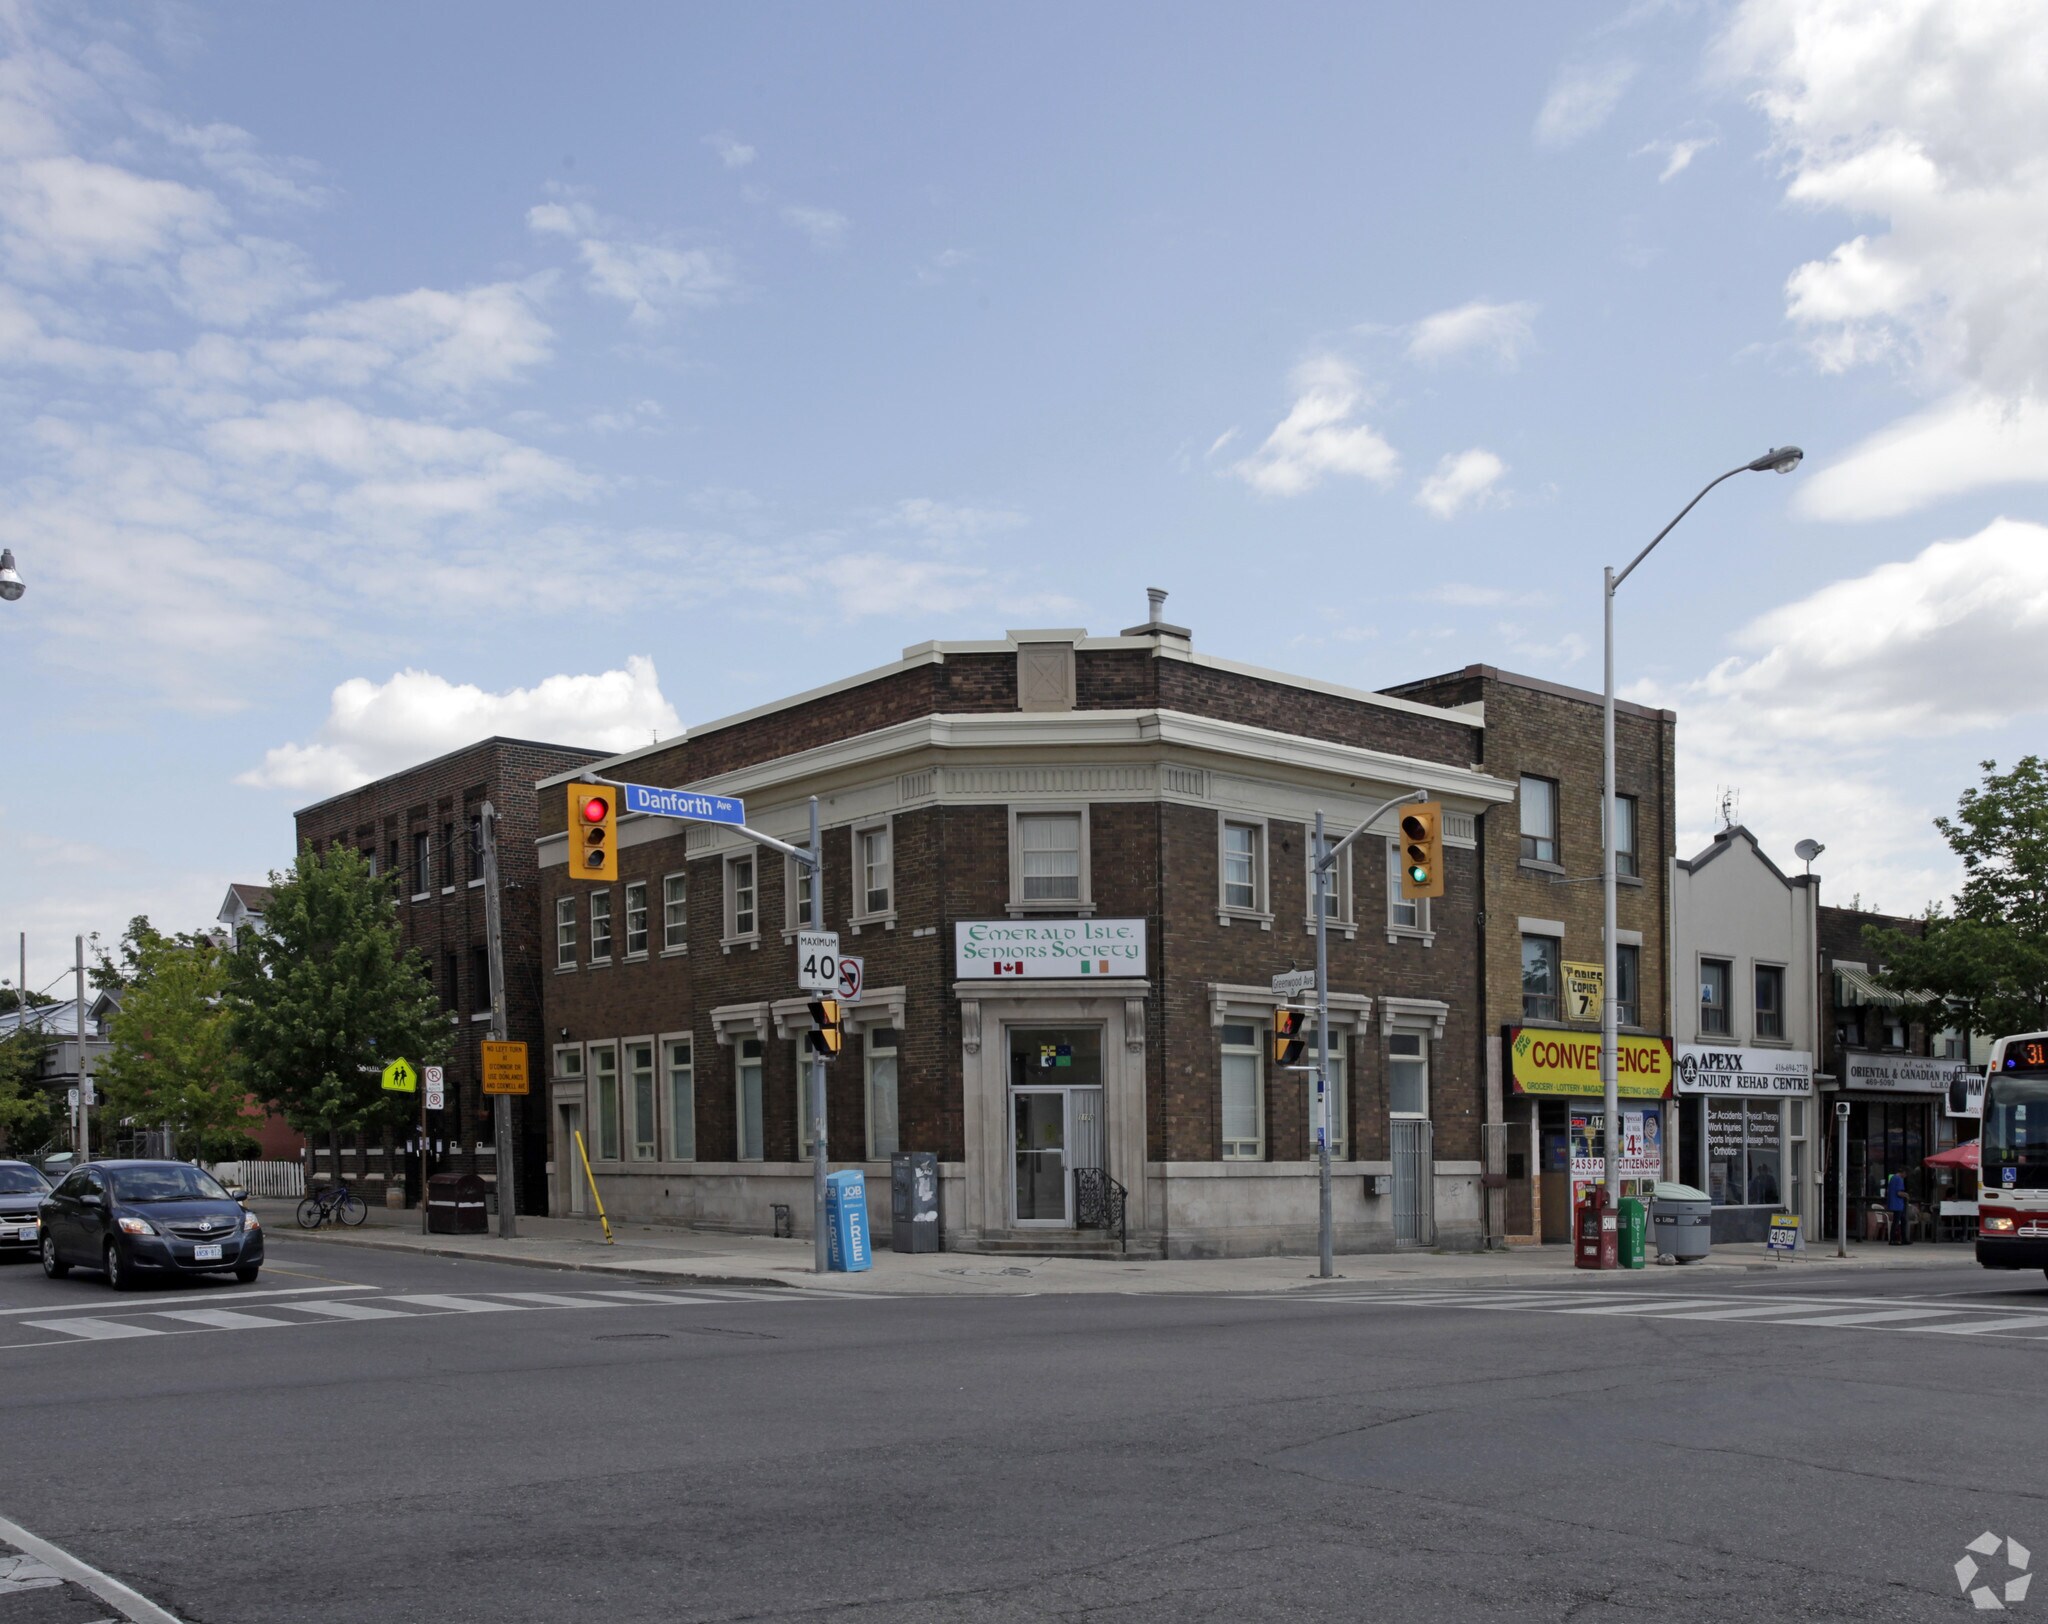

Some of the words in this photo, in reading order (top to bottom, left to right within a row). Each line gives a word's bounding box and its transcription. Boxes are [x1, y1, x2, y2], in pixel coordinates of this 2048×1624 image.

[638, 789, 712, 815] Danforth
[717, 800, 732, 811] Ave
[801, 937, 836, 947] MAXIMUM
[963, 942, 1047, 959] SENIORS
[803, 954, 835, 979] 40
[1274, 977, 1302, 989] Greenwood
[1303, 976, 1313, 986] Ave
[1572, 982, 1597, 994] COPIES
[1532, 1041, 1661, 1074] CONVEENCE
[2027, 1044, 2045, 1064] 31
[1700, 1053, 1743, 1070] APEXX
[1851, 1066, 1889, 1079] ORIENTAL
[1892, 1068, 1898, 1079] &
[1900, 1069, 1940, 1081] CANADIAN
[1698, 1074, 1732, 1088] INJURY
[1737, 1076, 1768, 1089] REHAB
[1773, 1077, 1809, 1090] CENTRE
[1527, 1081, 1553, 1091] GROCERY
[1556, 1083, 1580, 1092] LOTTERY
[1643, 1087, 1660, 1096] CARDS
[1625, 1115, 1642, 1123] Special
[1708, 1111, 1717, 1119] Car
[1717, 1111, 1742, 1120] Accidents
[1746, 1112, 1762, 1121] Physical
[1763, 1112, 1779, 1122] Therapy
[1591, 1116, 1604, 1128] AT
[1708, 1123, 1722, 1131] Work
[1723, 1123, 1742, 1133] Injuries
[1750, 1123, 1775, 1133] Chiropractor
[1708, 1135, 1723, 1145] Sports
[1725, 1135, 1743, 1145] Injuries
[1764, 1135, 1779, 1146] Therapy
[1714, 1147, 1737, 1155] Orthotics
[1570, 1159, 1604, 1169] PASSPO
[1618, 1158, 1660, 1169] CITIZENSHIP
[826, 1187, 836, 1197] OB
[843, 1185, 862, 1197] JOB
[1602, 1217, 1616, 1230] SUN
[828, 1215, 840, 1262] FREE
[849, 1213, 864, 1262] FREE
